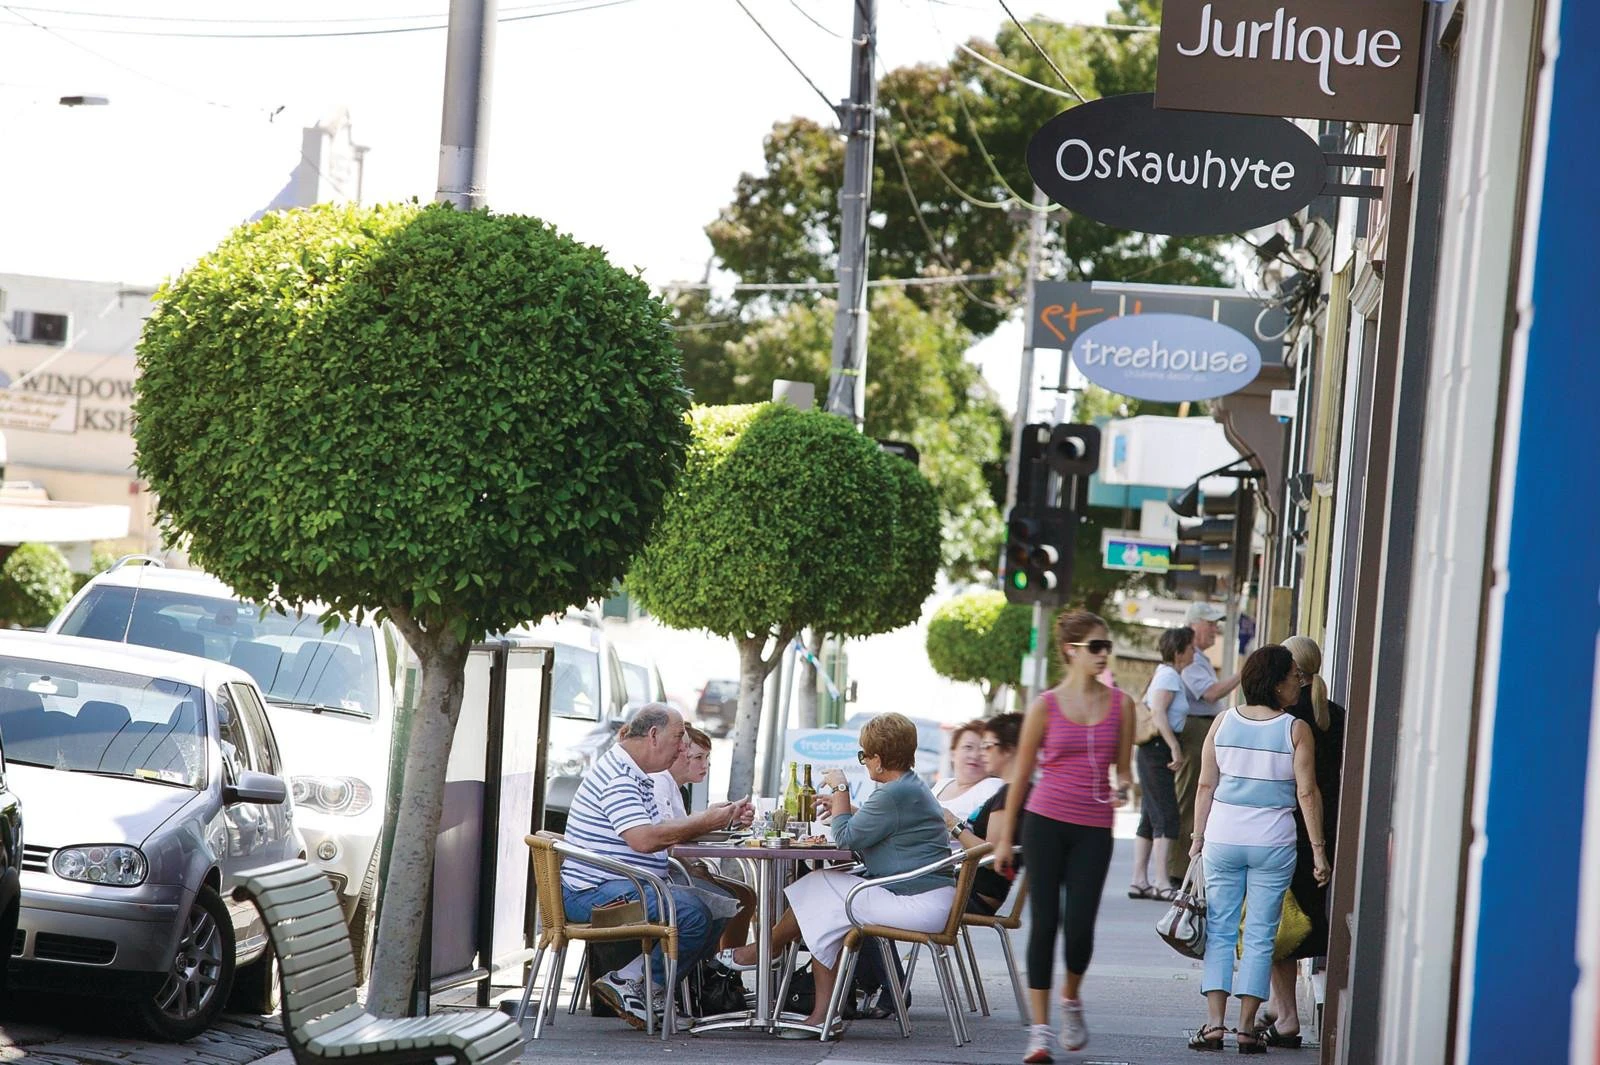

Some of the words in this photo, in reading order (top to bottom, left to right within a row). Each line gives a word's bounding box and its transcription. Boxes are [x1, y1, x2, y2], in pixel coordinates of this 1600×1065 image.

[1176, 4, 1402, 96] Jurlique
[1055, 138, 1296, 192] Oskawhyte
[1081, 338, 1249, 374] treehouse
